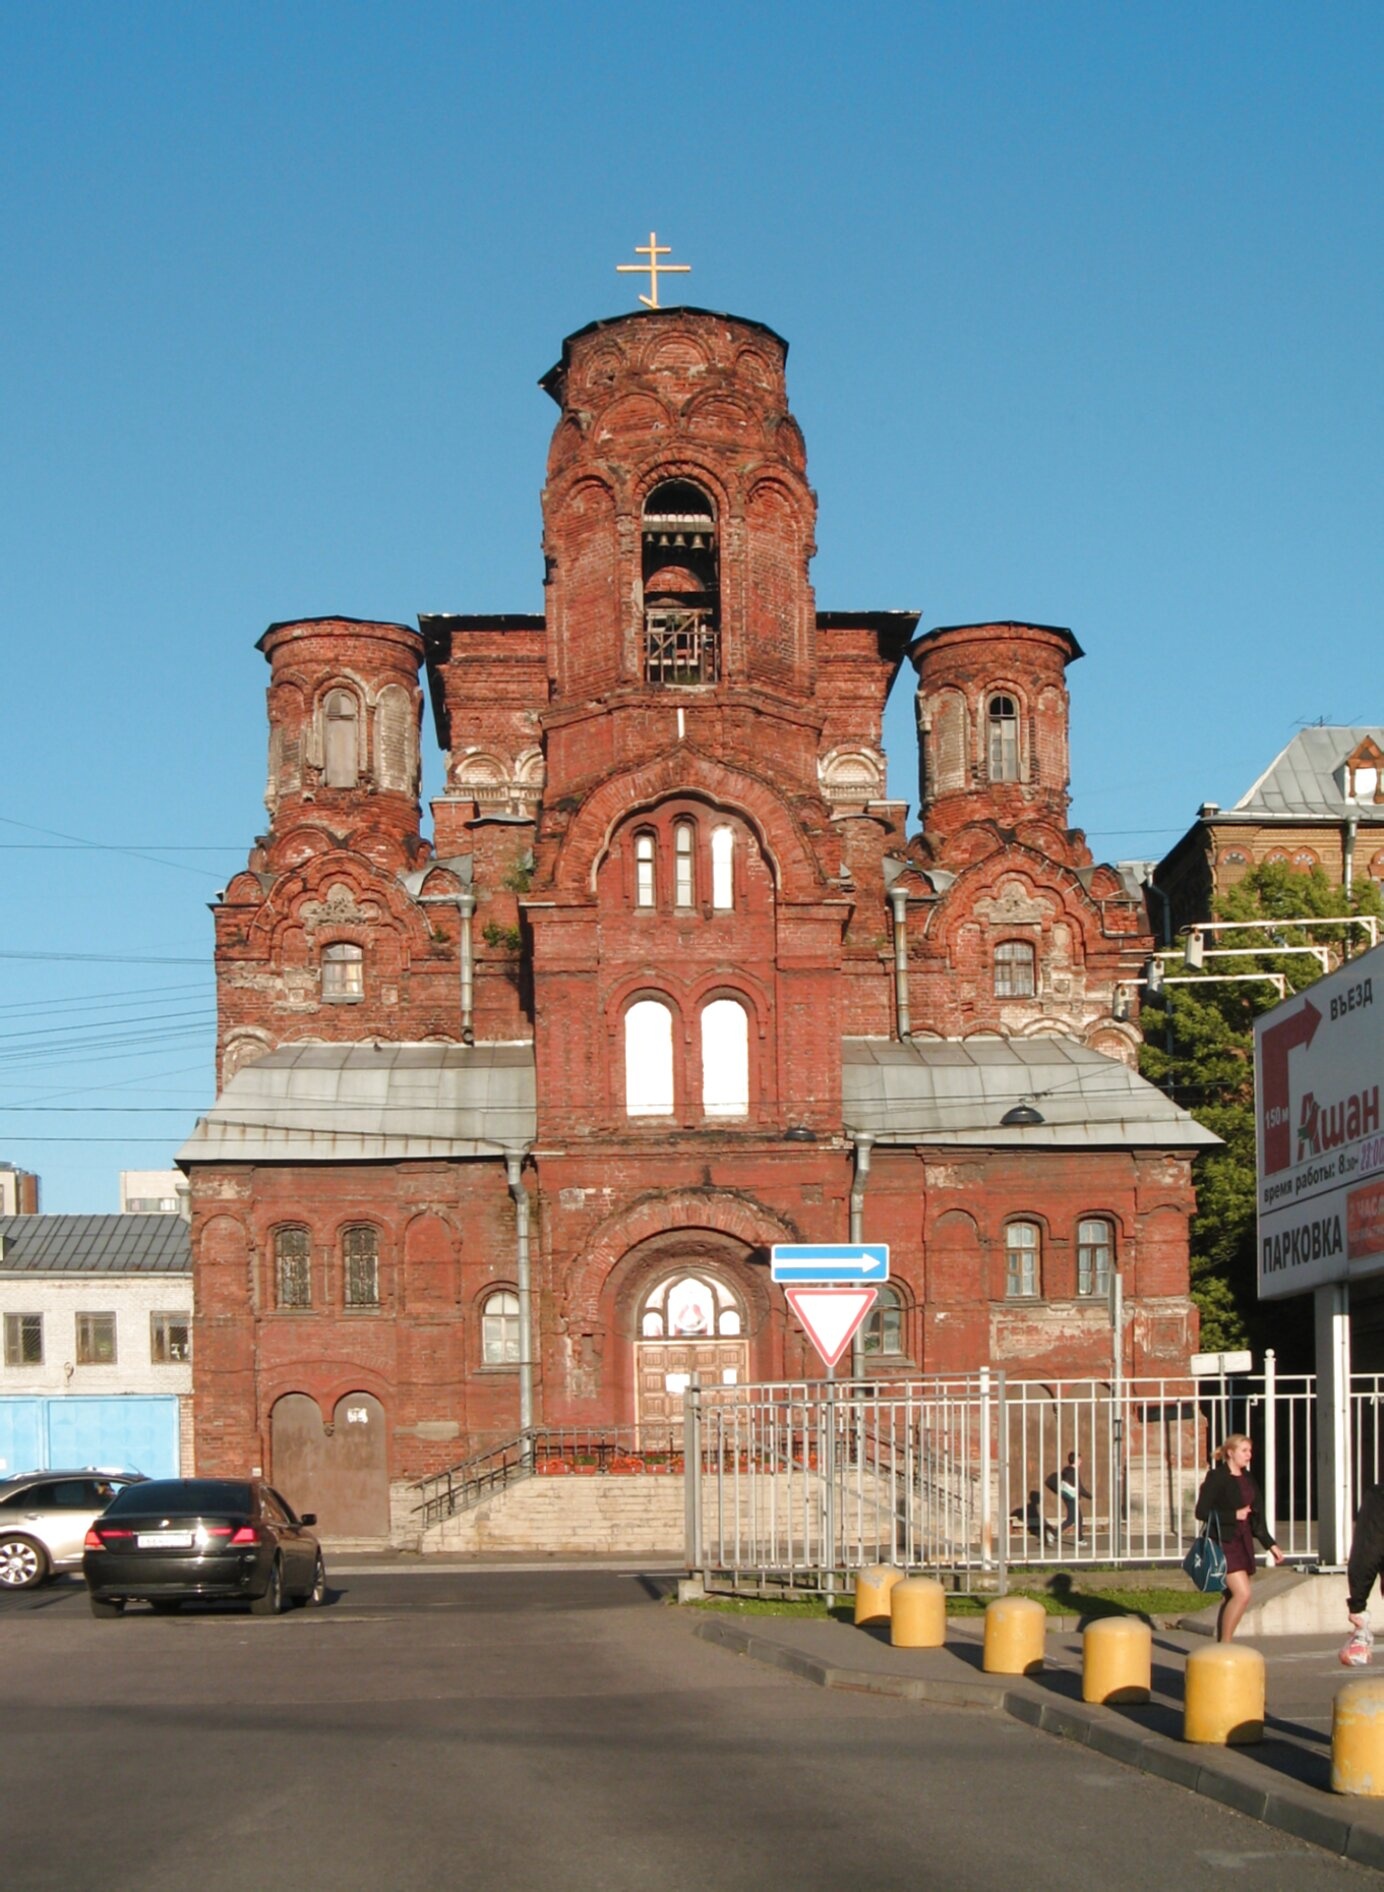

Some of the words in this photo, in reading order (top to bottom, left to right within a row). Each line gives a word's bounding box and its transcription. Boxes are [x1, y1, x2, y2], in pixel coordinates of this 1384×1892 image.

[1330, 978, 1373, 1021] ВЪЕЗД
[1265, 1106, 1281, 1130] 150
[1297, 1085, 1379, 1161] Ашан
[1264, 1179, 1292, 1205] время
[1296, 1163, 1335, 1196] работы:
[1263, 1215, 1343, 1274] ПАРКОВКА
